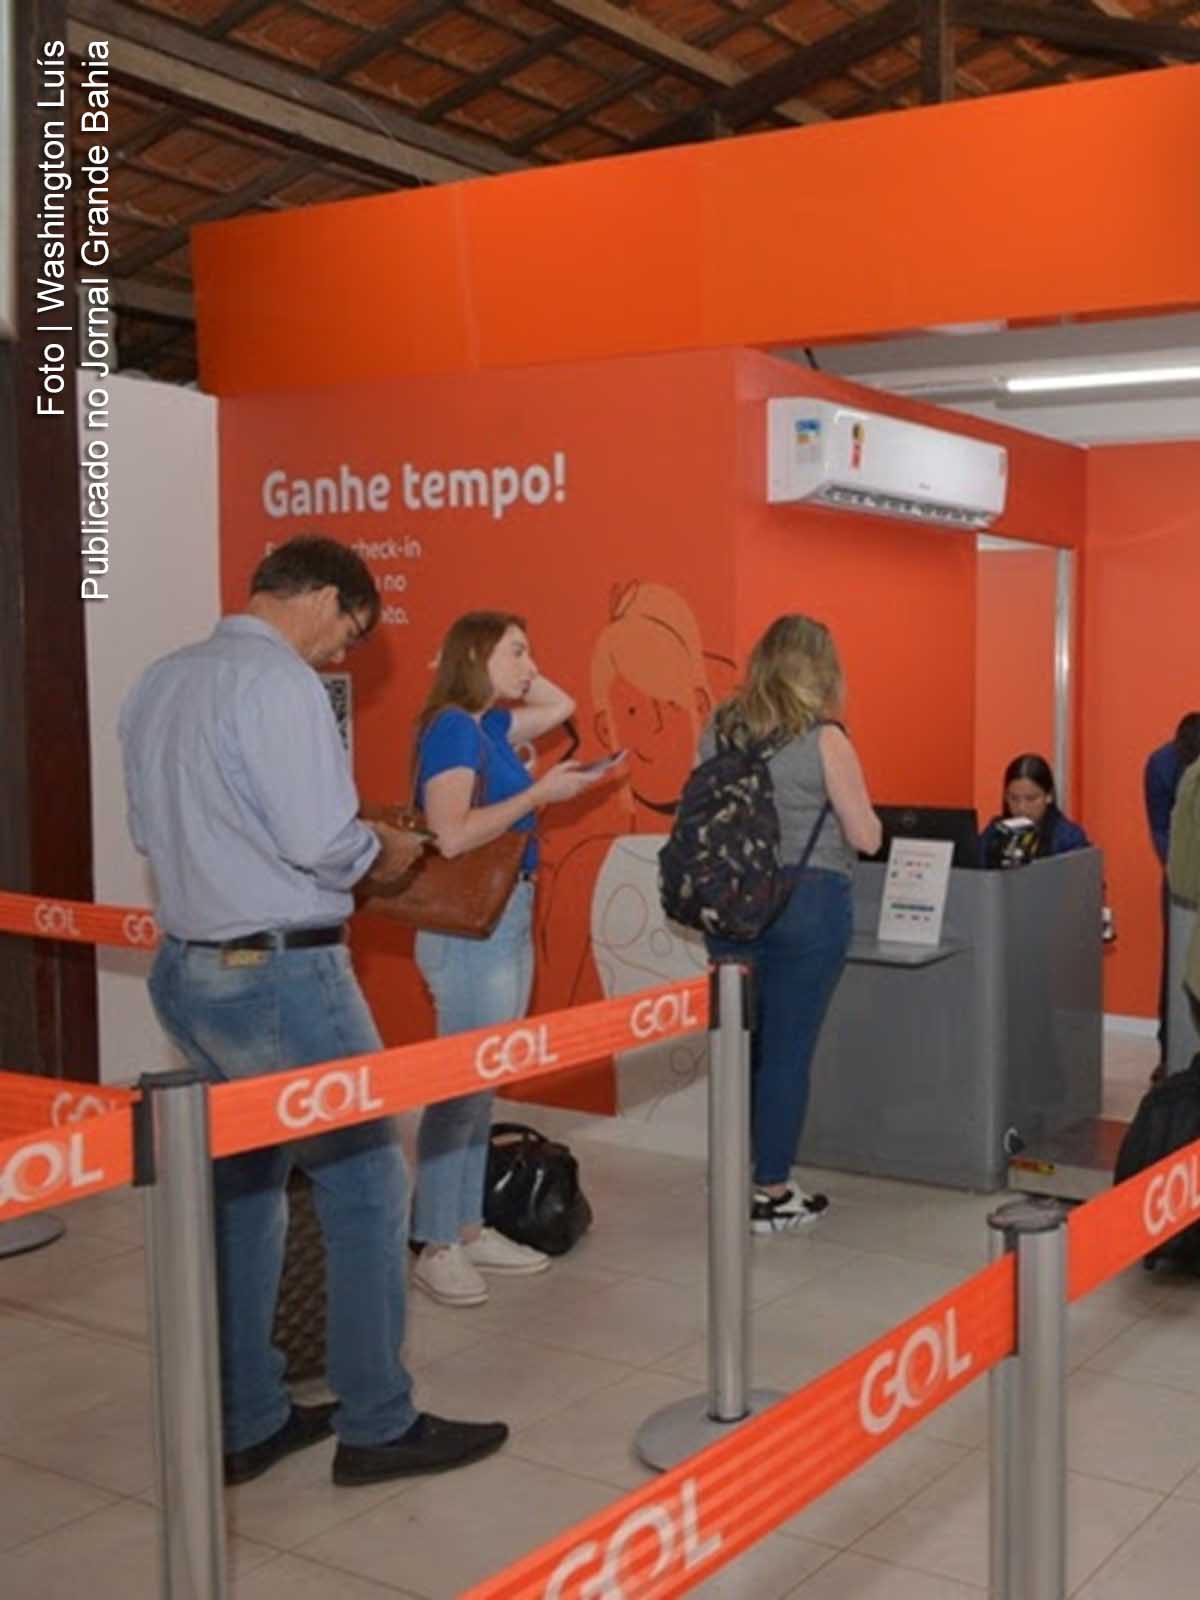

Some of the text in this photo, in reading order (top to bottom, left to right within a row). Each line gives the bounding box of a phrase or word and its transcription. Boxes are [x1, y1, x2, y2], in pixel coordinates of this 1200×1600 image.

[262, 451, 567, 520] Ganhe tempo!
[34, 903, 81, 937] GOL
[276, 989, 698, 1130] GOL GOL GOL
[0, 1131, 105, 1207] OL
[858, 1307, 972, 1435] GOL
